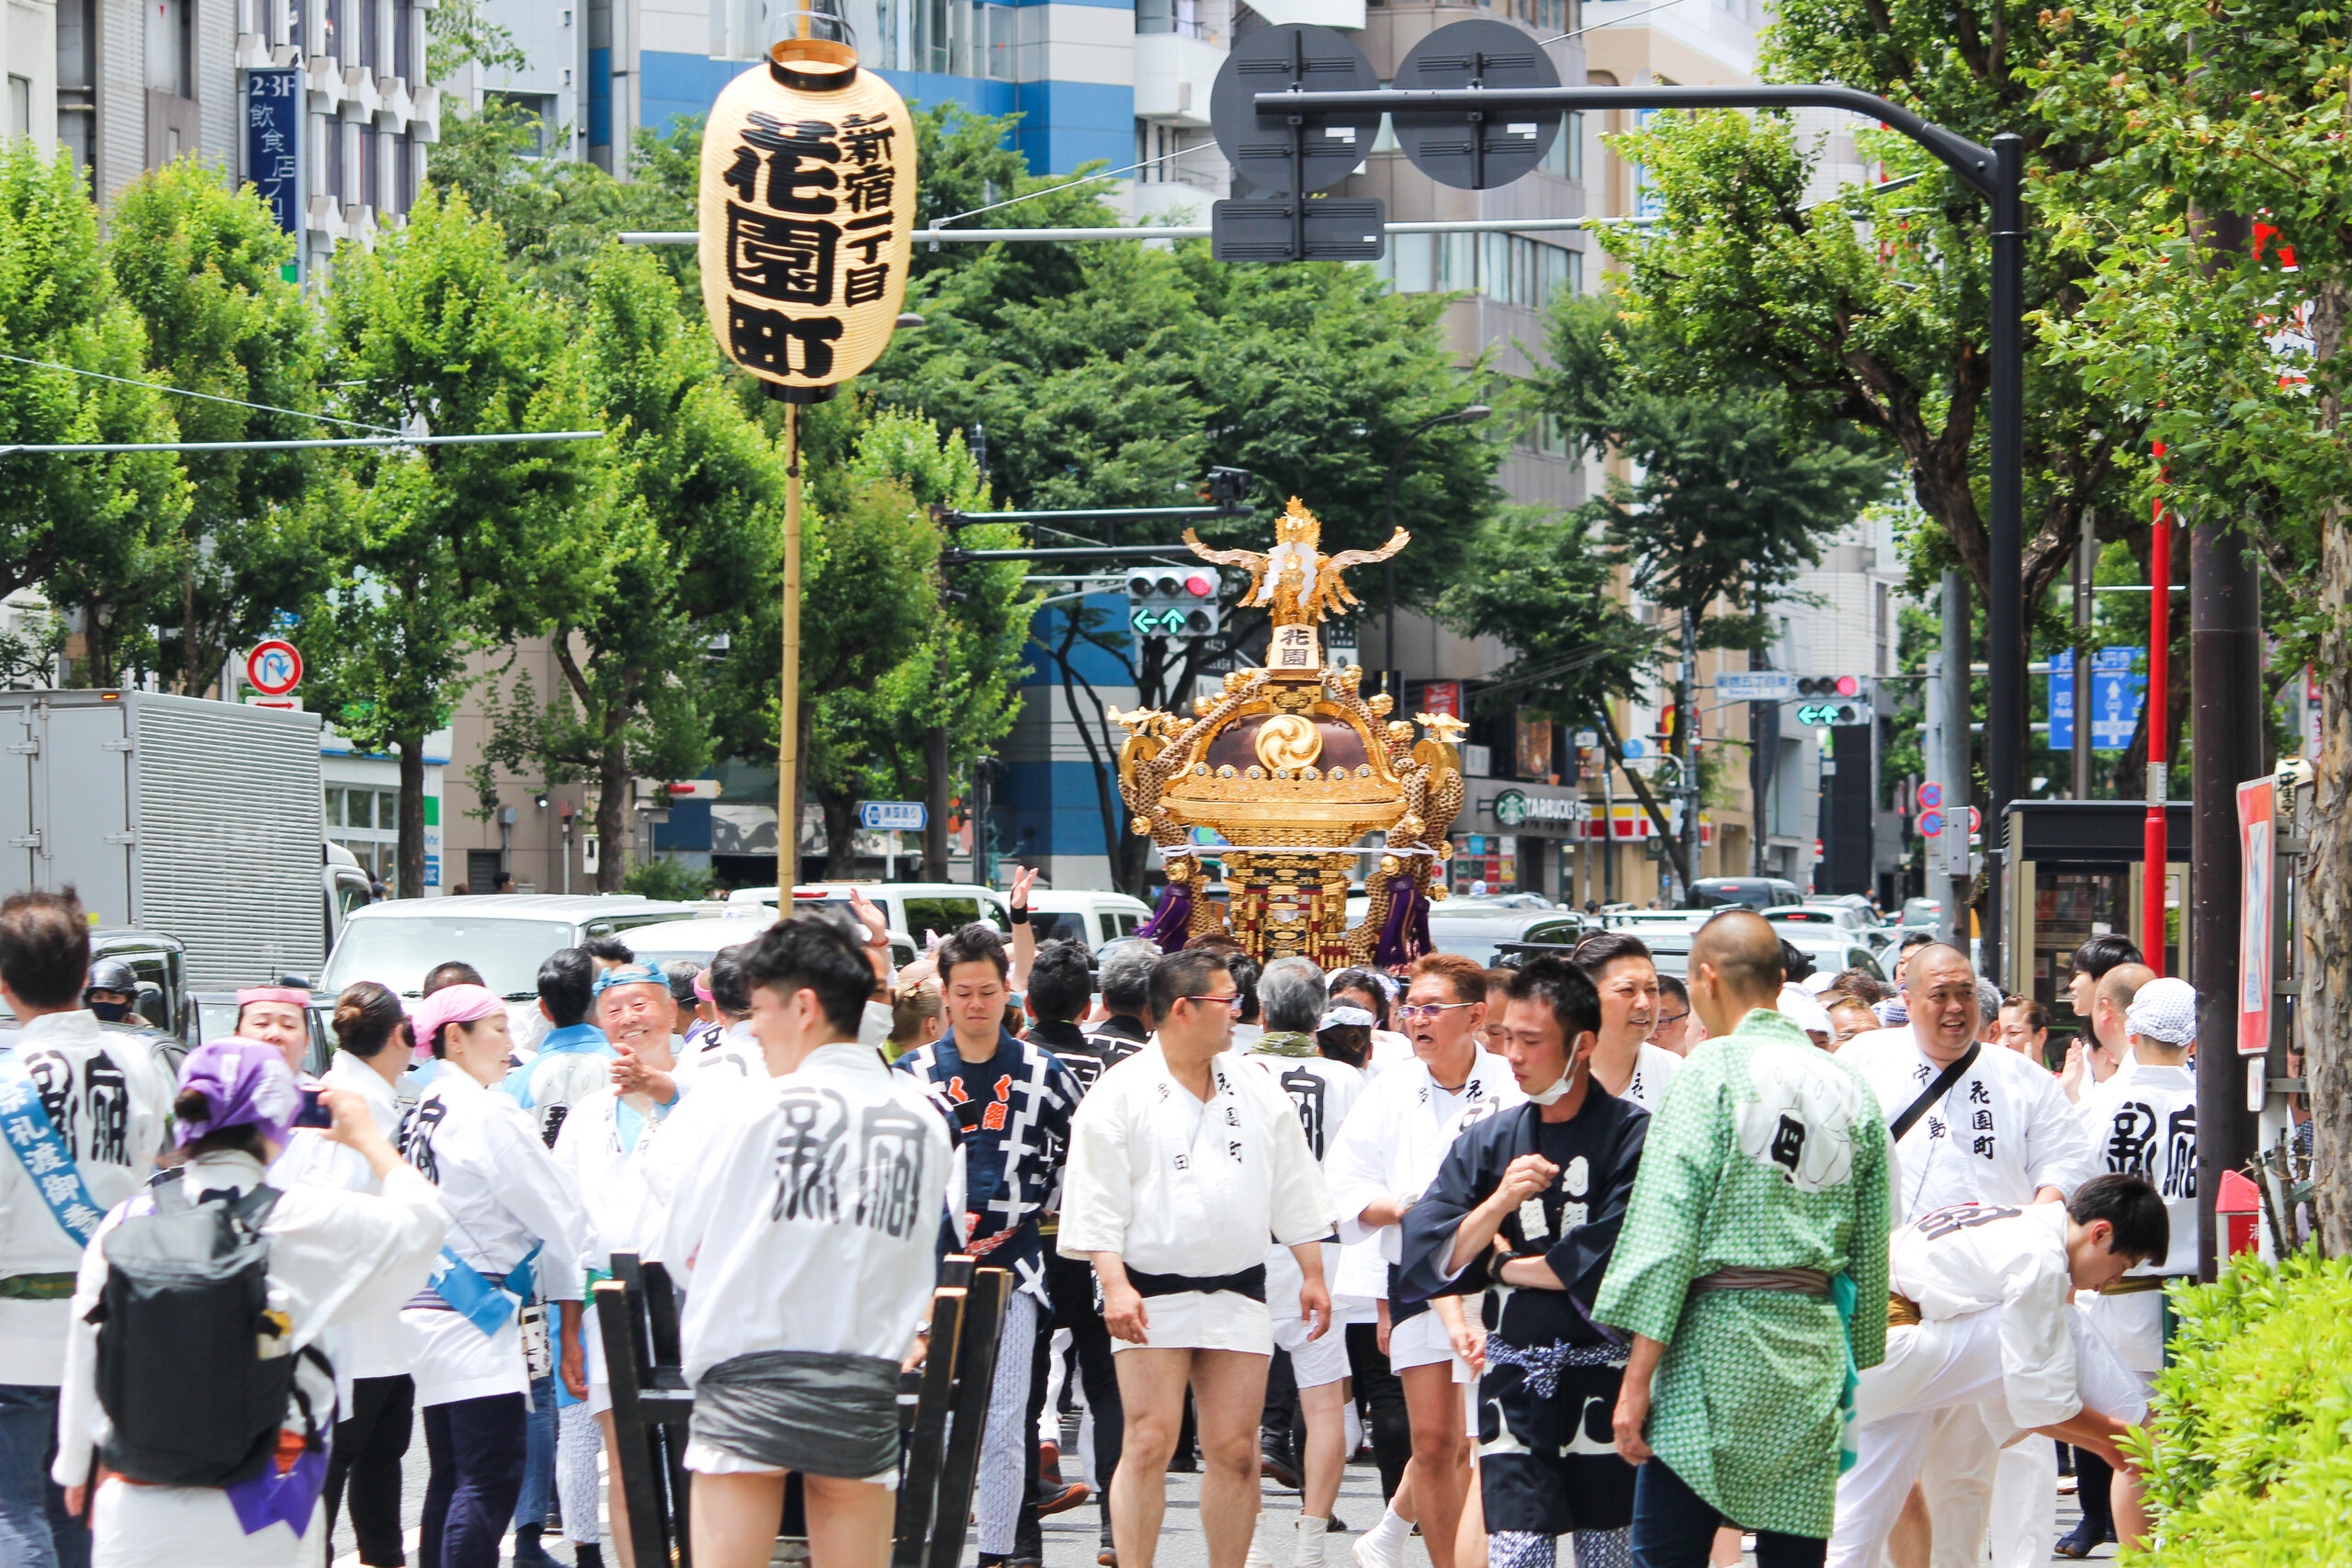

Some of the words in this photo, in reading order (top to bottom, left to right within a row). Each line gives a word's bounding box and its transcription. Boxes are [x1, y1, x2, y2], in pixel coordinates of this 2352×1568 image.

[723, 110, 844, 379] 花園町
[1280, 628, 1309, 667] 花園
[1525, 797, 1576, 820] TARBUCKS
[1969, 1079, 1996, 1159] 花園町
